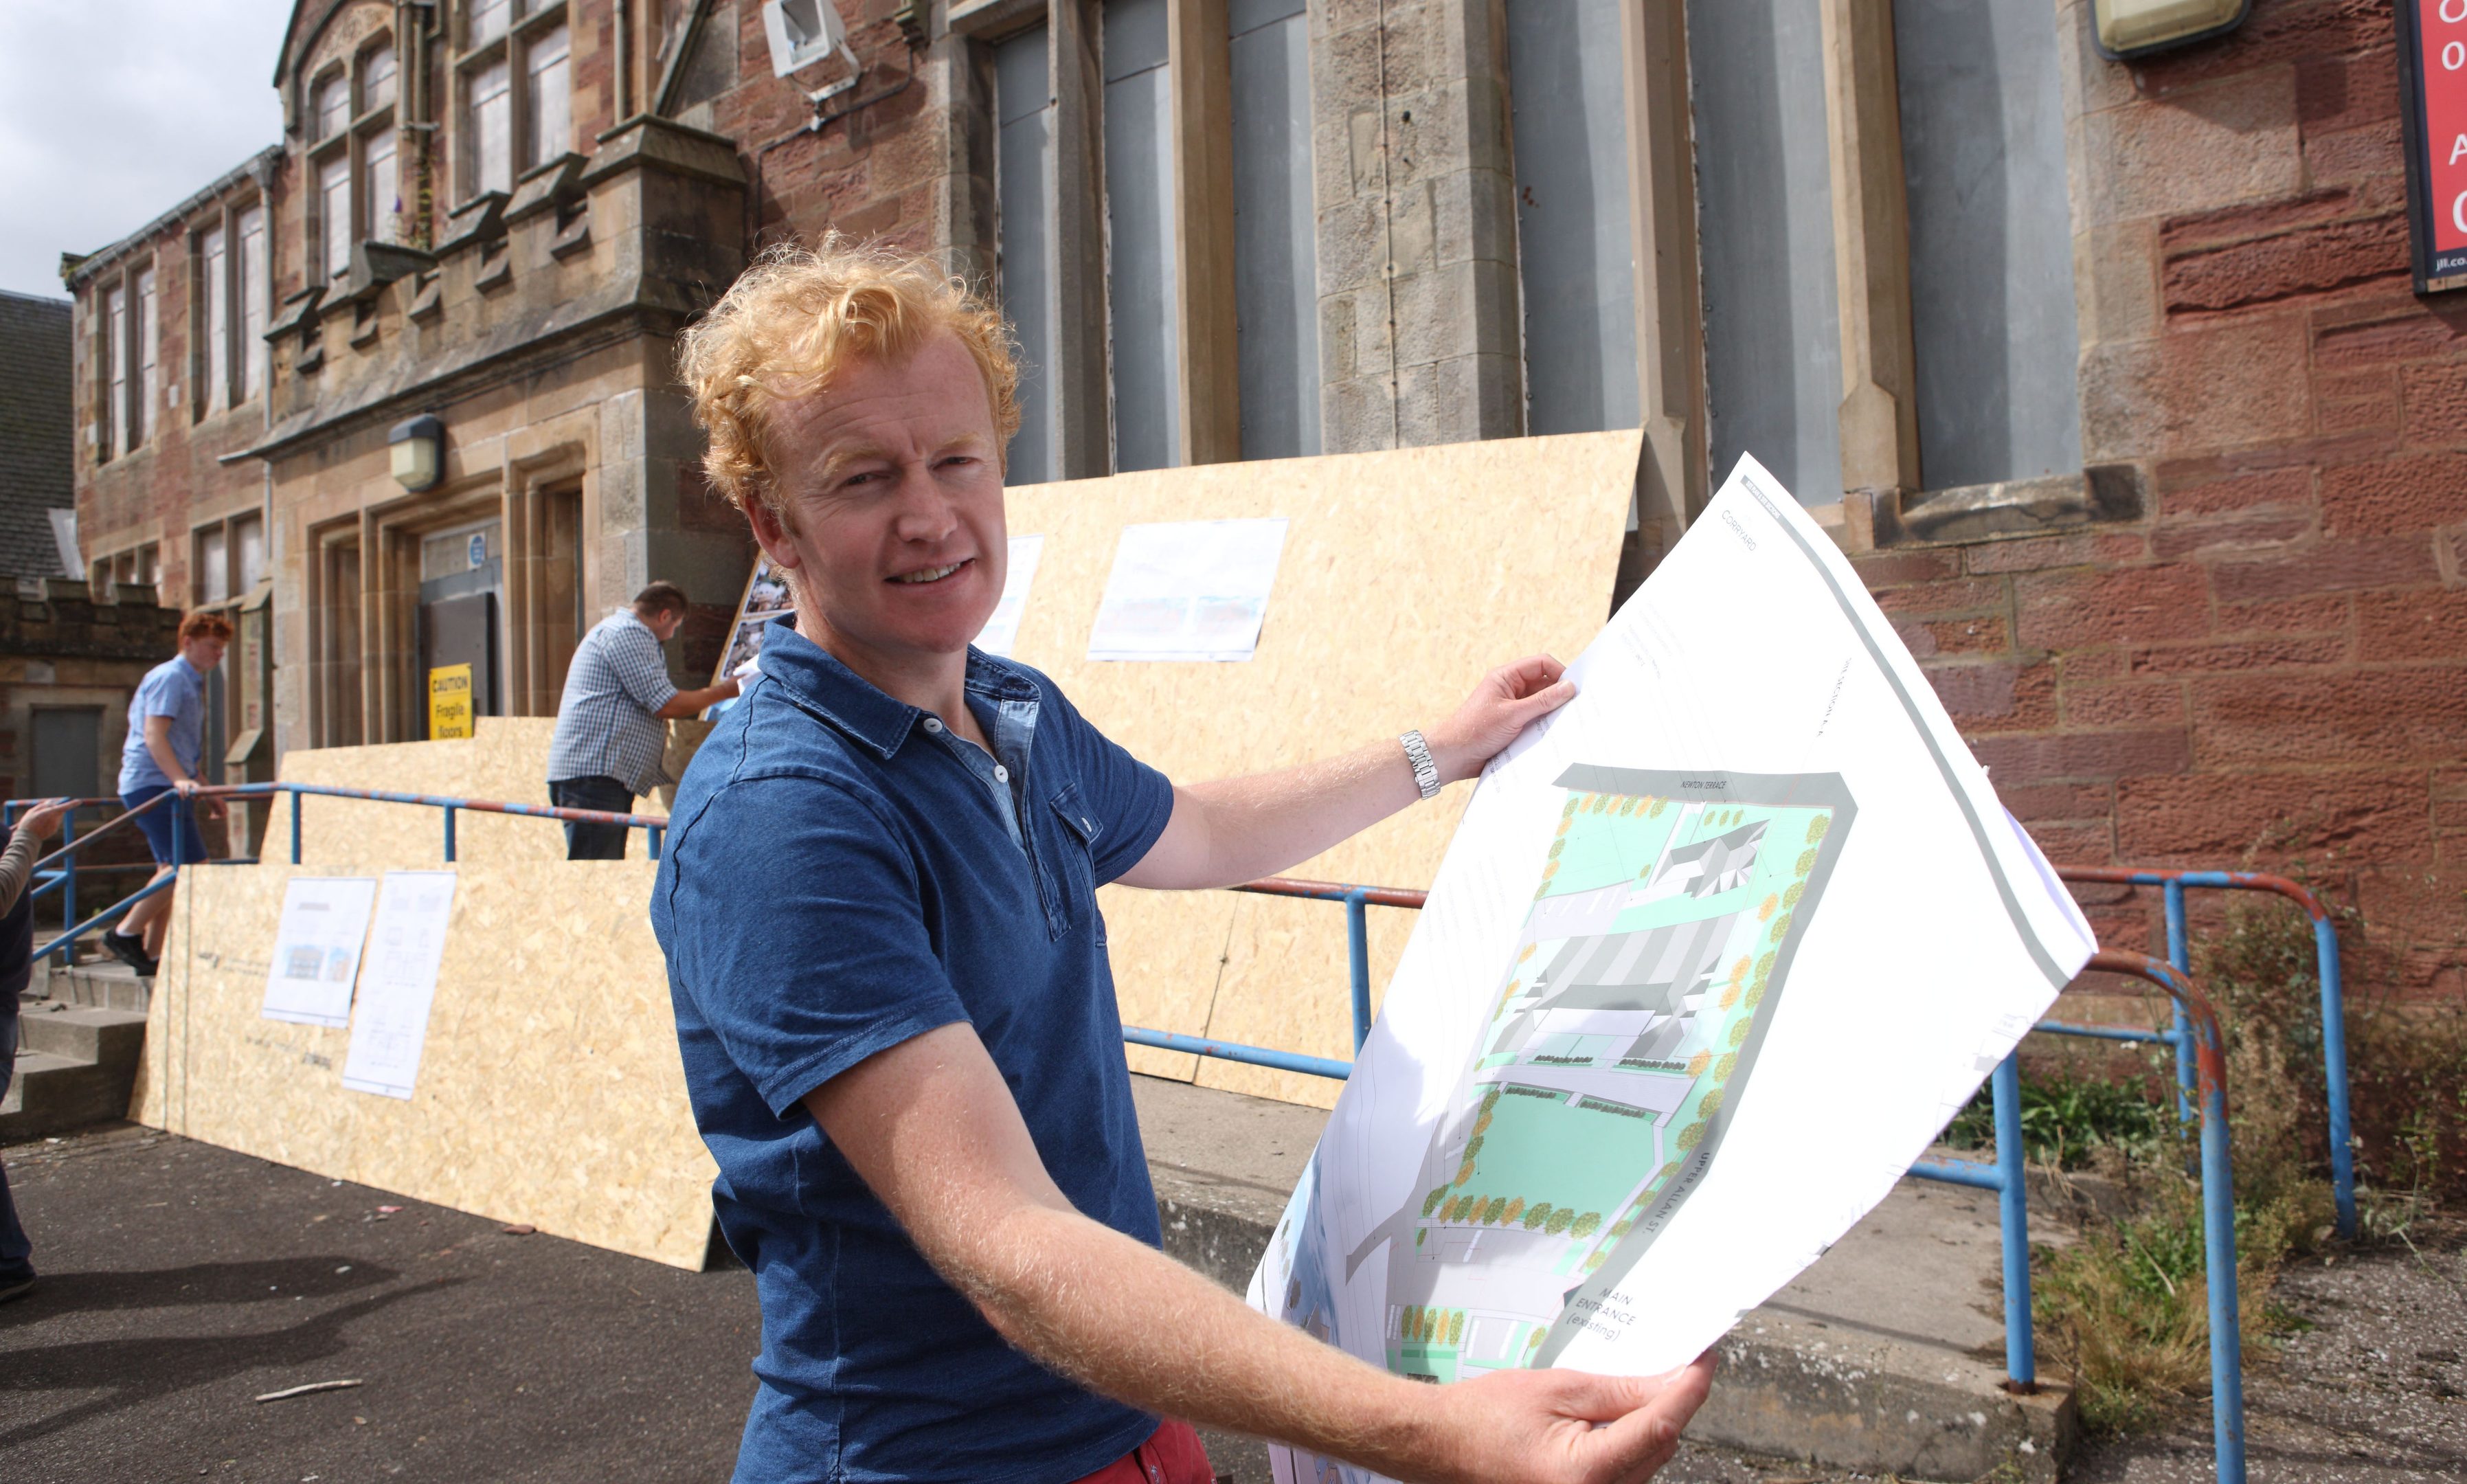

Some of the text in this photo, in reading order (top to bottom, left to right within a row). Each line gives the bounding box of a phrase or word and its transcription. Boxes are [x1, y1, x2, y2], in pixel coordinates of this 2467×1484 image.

[1722, 510, 1757, 551] CORRYARD
[433, 676, 469, 693] CAUTION
[1825, 676, 1845, 717] SECTION
[436, 702, 464, 720] Fragile
[1680, 780, 1727, 789] NEWTON TERRACE
[1683, 1152, 1710, 1184] UPPER
[1655, 1185, 1686, 1219] ALLAN
[1599, 1287, 1634, 1305] MAIN
[1575, 1297, 1636, 1326] ENTRANCE
[1566, 1312, 1621, 1342] (existing)
